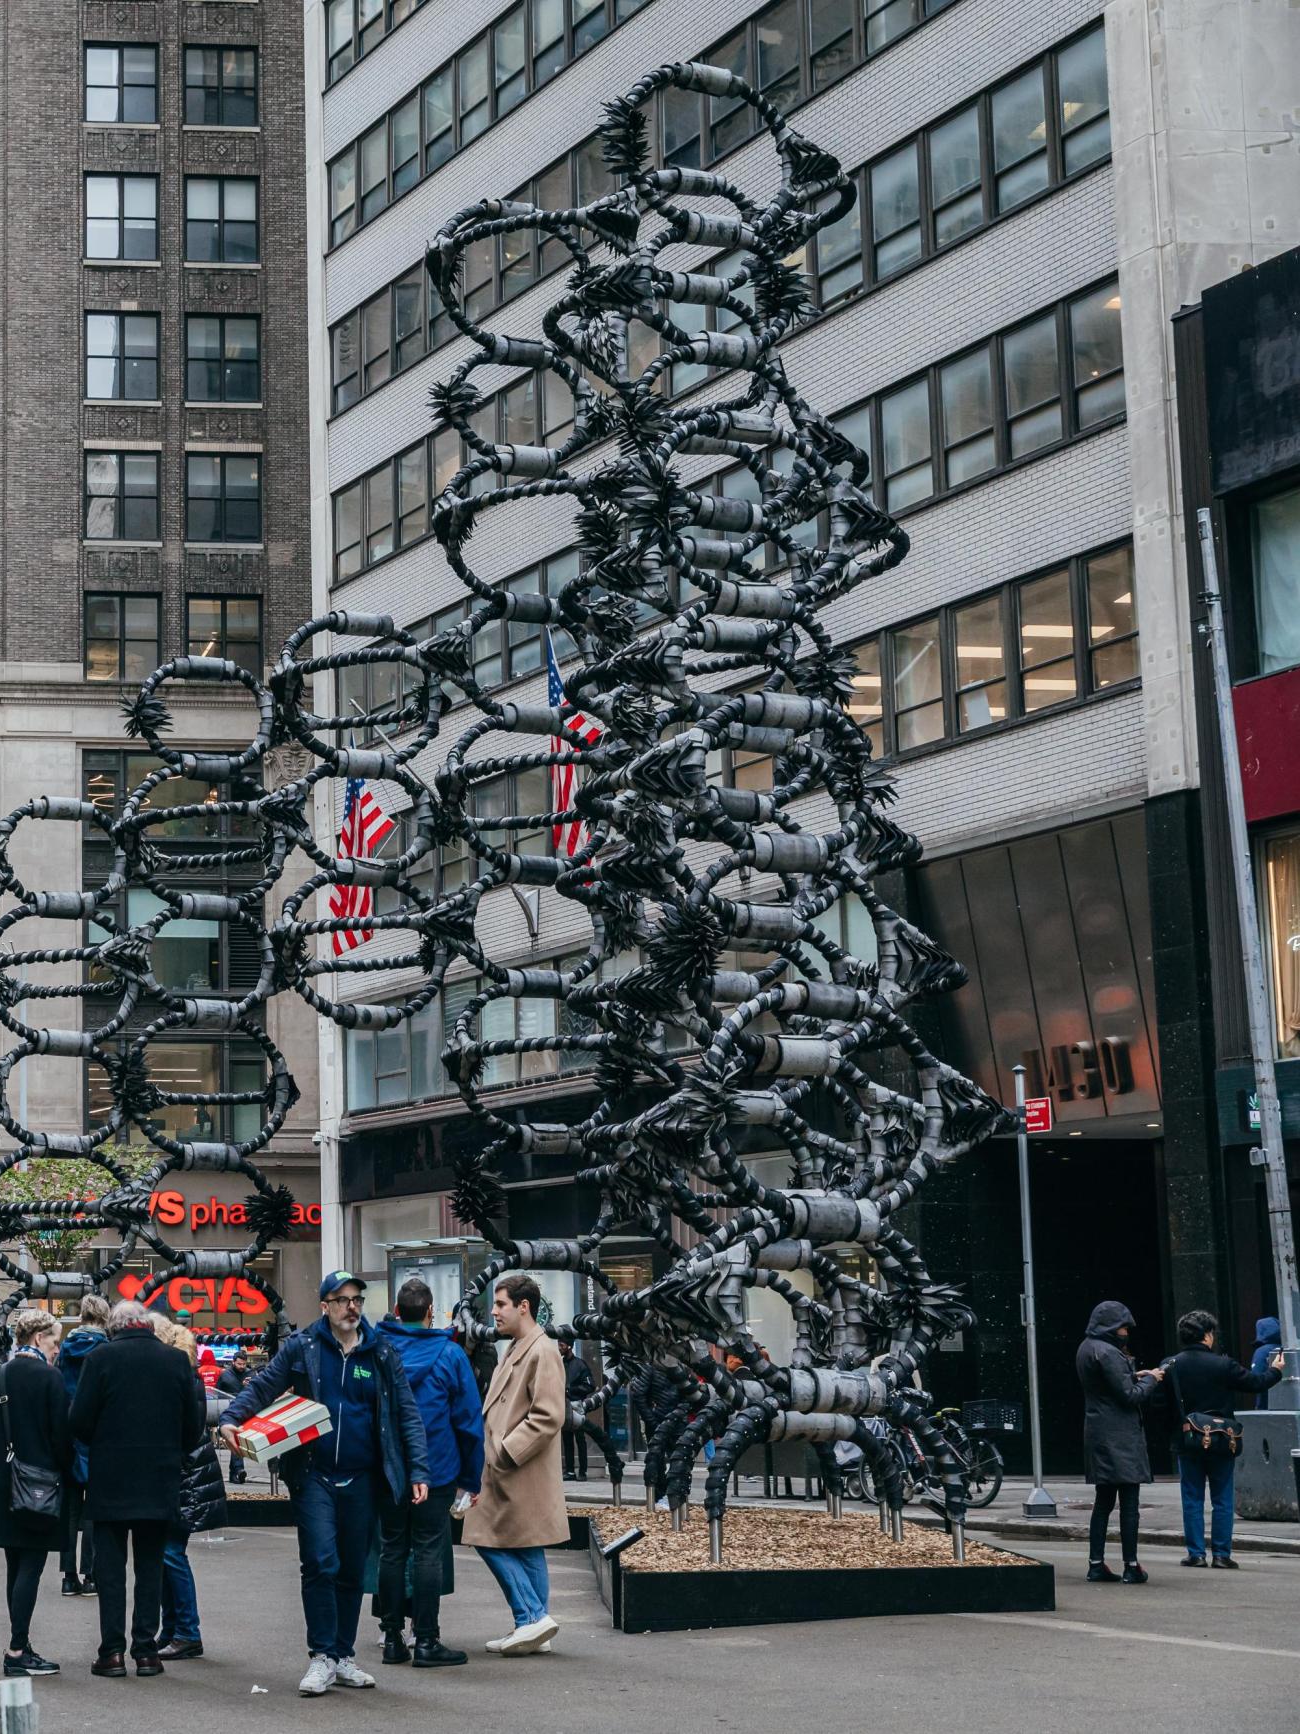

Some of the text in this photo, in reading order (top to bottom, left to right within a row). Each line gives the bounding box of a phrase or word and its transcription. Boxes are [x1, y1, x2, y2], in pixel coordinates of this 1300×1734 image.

[1022, 1036, 1135, 1102] 1430
[191, 1195, 321, 1232] phaac
[168, 1276, 270, 1315] CVS
